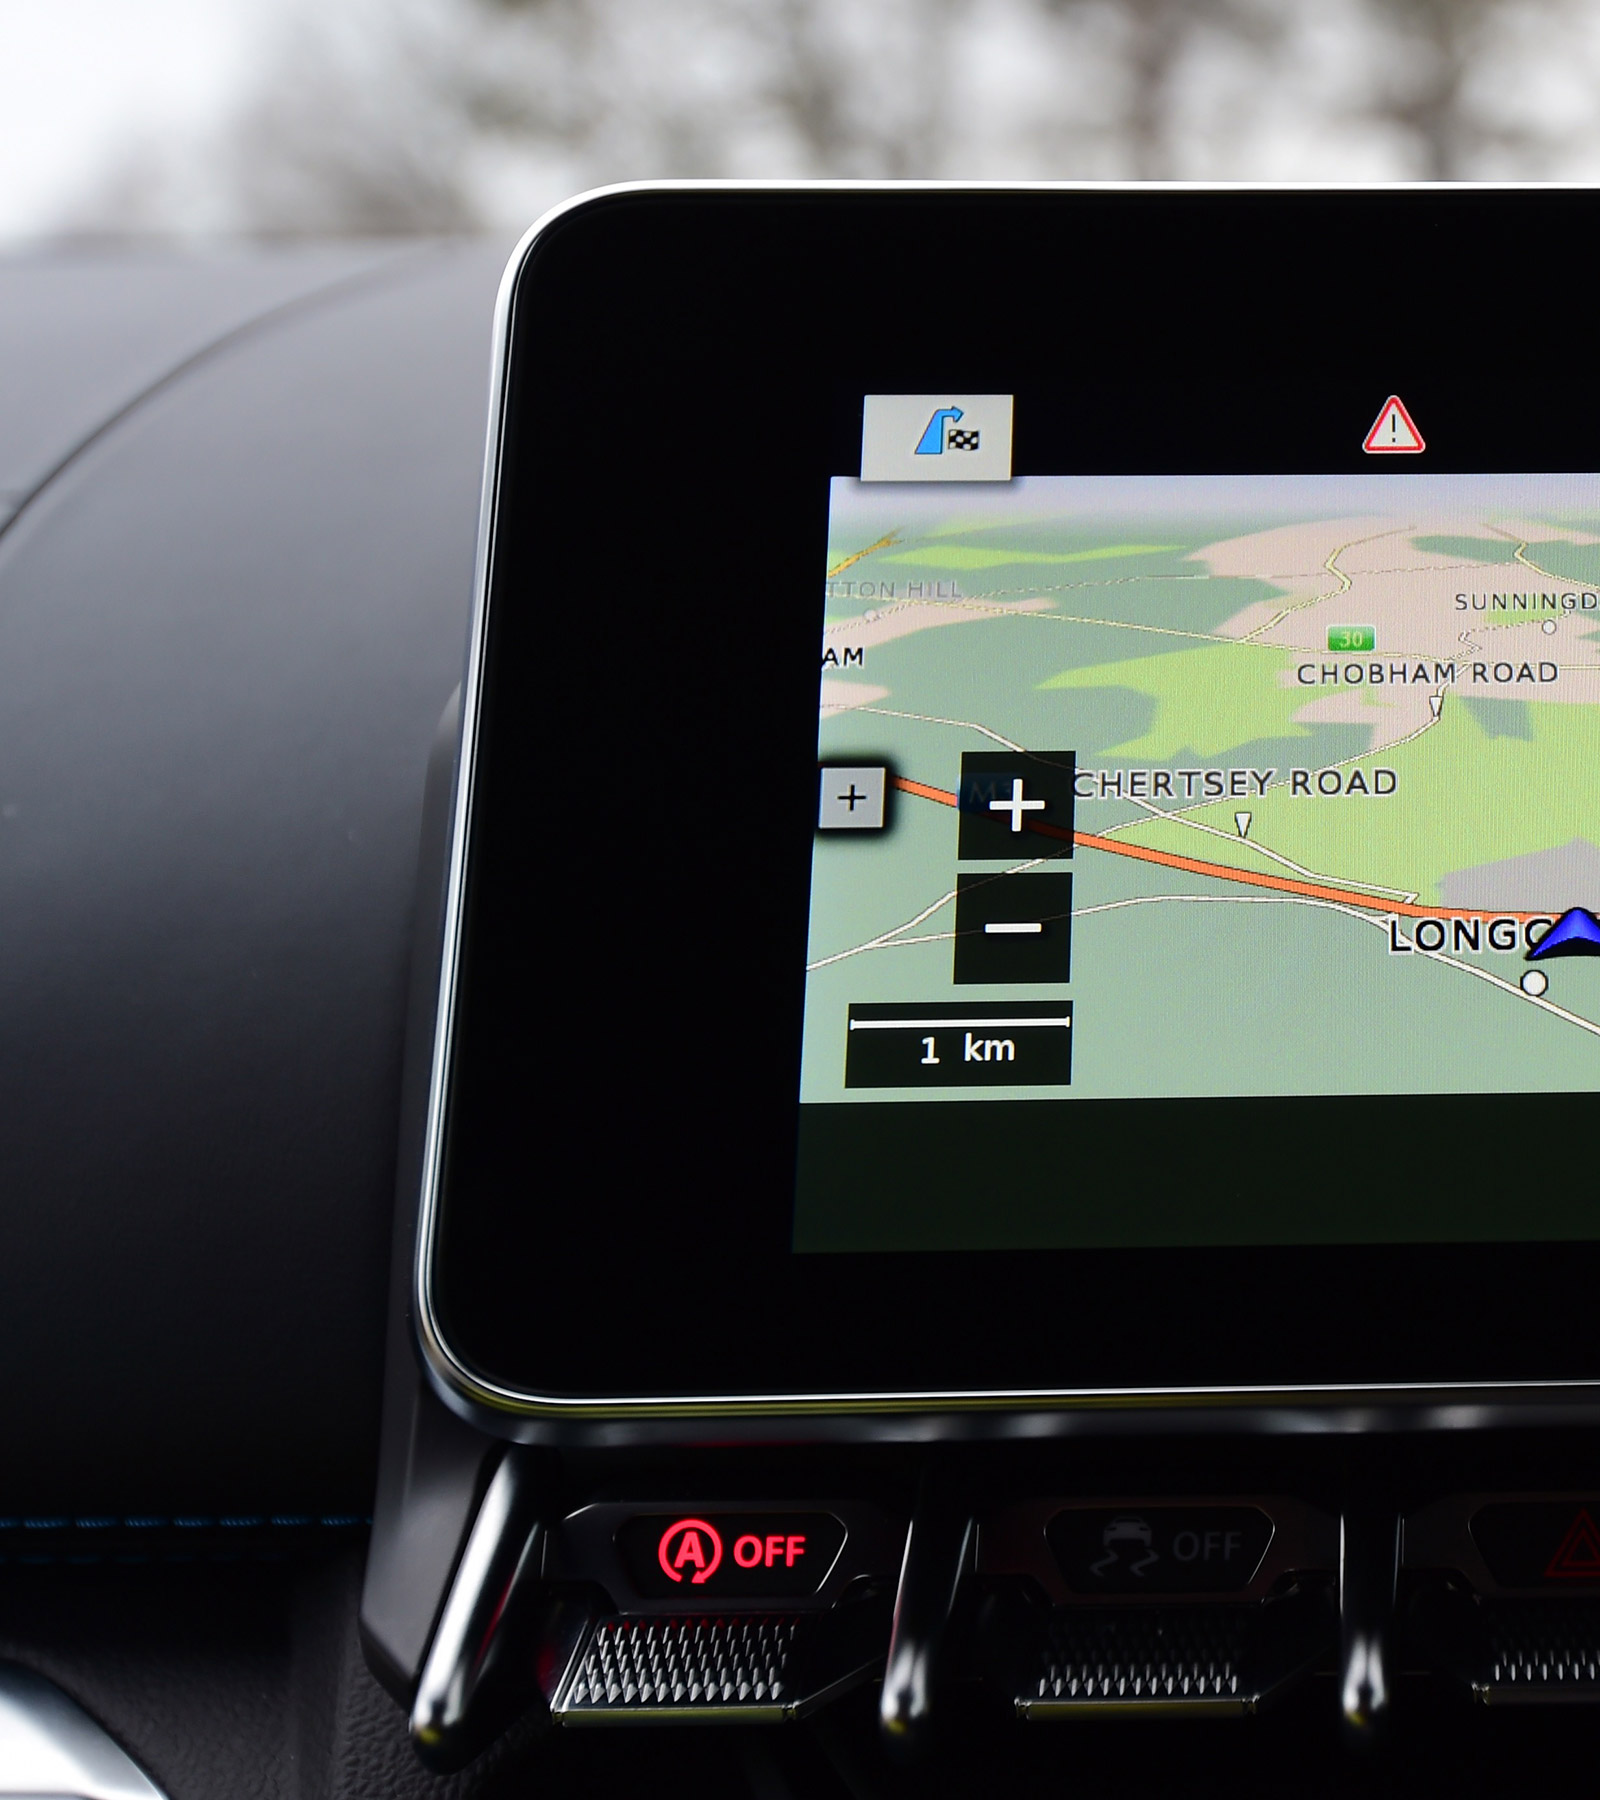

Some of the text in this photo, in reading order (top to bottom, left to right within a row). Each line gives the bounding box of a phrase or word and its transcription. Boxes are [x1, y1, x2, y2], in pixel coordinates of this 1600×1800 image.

[908, 581, 962, 598] HILL
[1340, 631, 1363, 648] 30
[822, 647, 864, 667] AM
[1297, 662, 1559, 685] CHOBHAM ROAD
[1073, 769, 1397, 798] CHERTSEY ROAD
[920, 1032, 1015, 1064] 1 km
[733, 1534, 806, 1568] OFF
[1172, 1530, 1243, 1563] OFF
